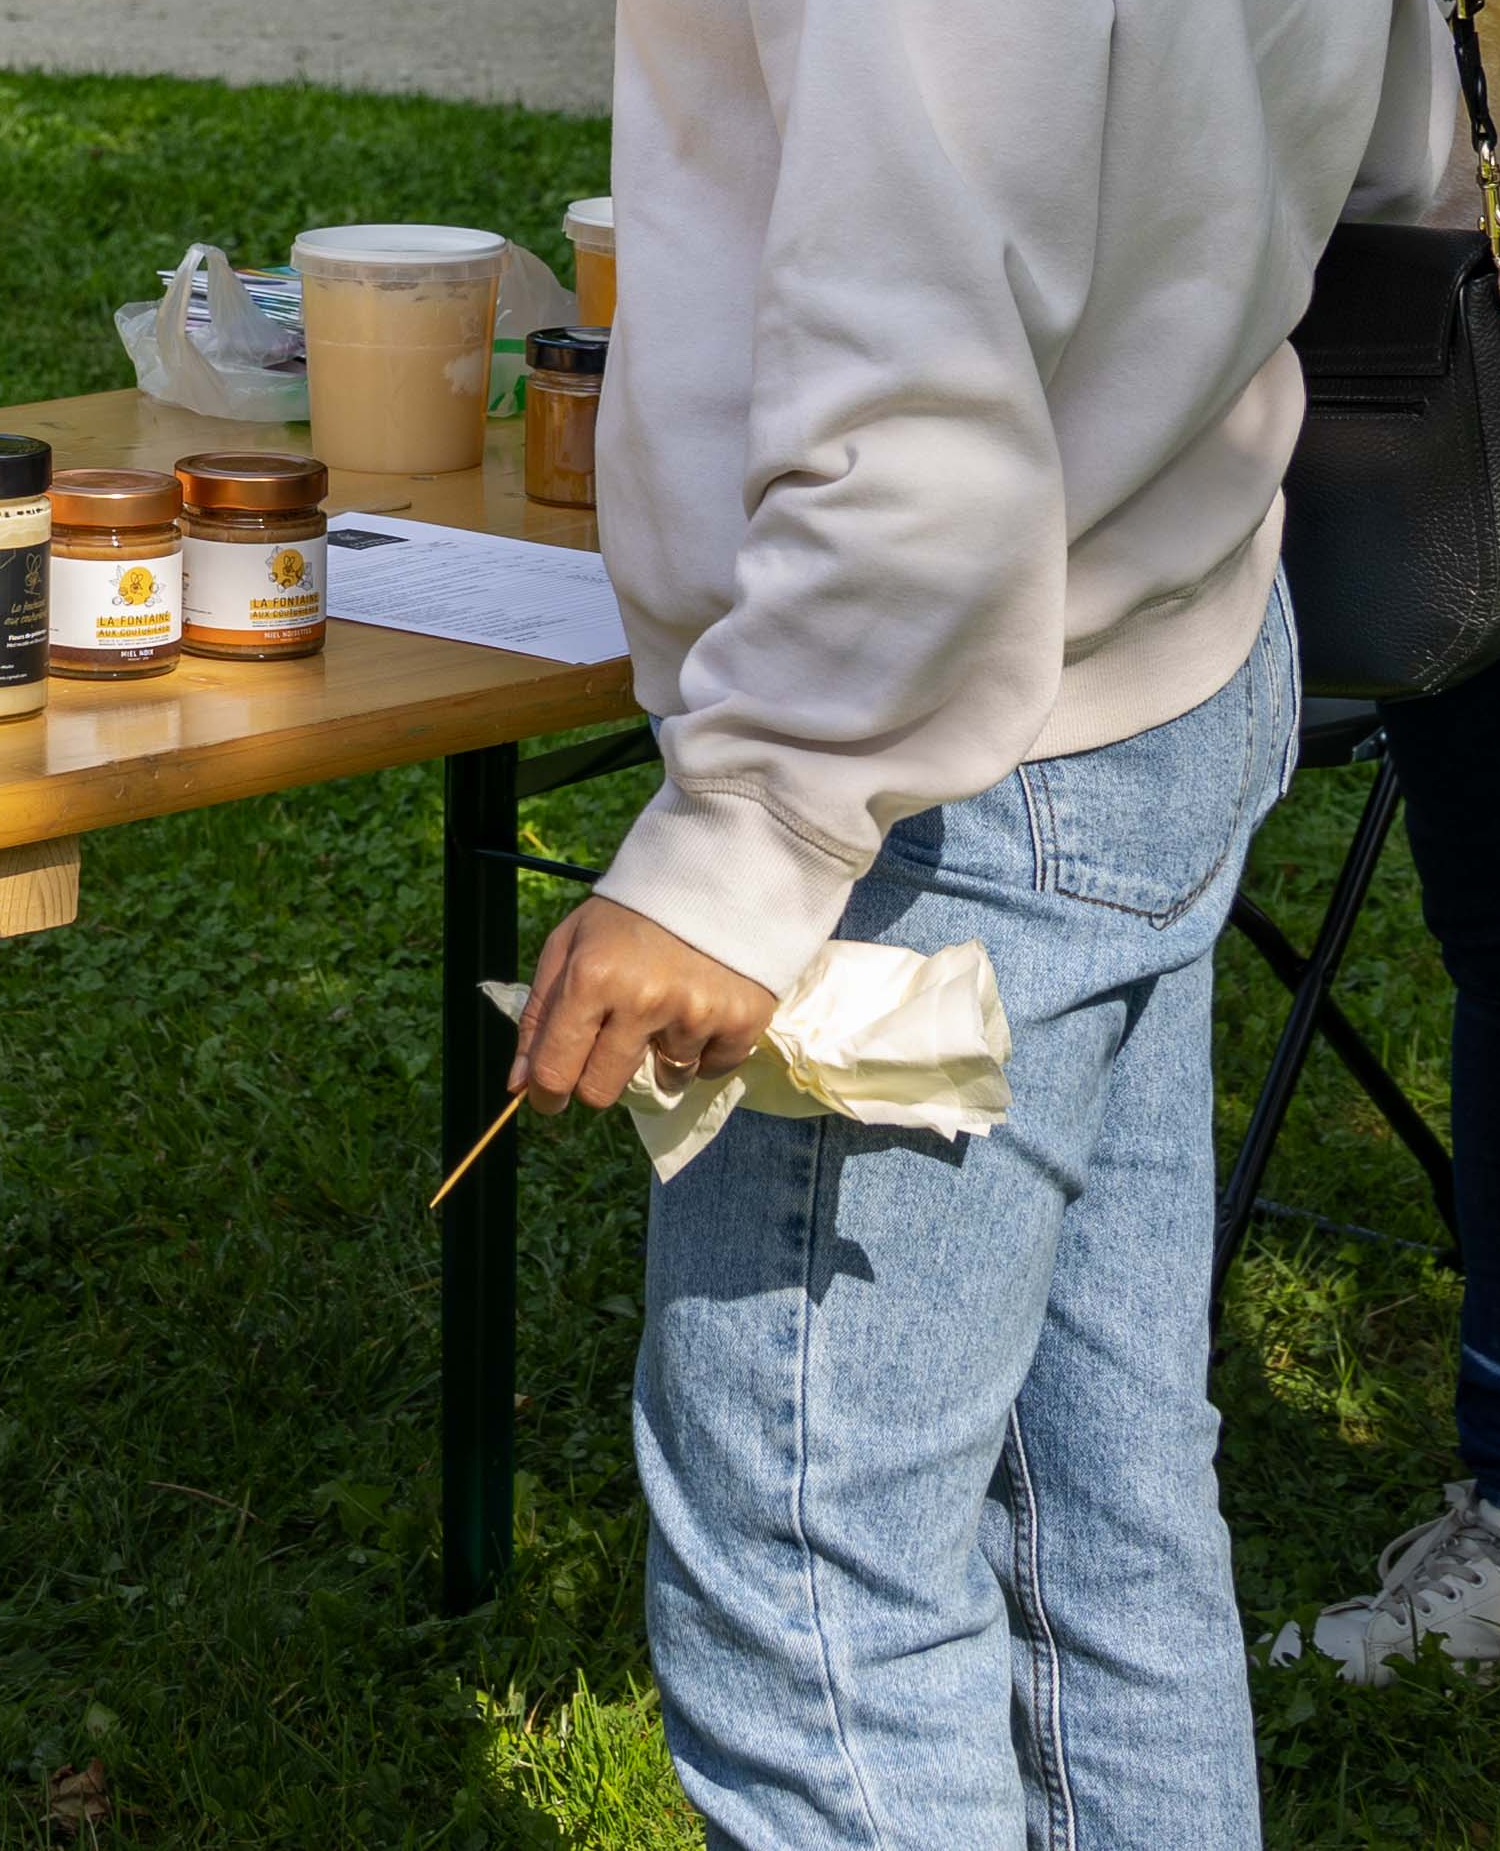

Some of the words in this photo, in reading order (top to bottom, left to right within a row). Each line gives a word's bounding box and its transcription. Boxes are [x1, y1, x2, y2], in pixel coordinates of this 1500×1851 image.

[253, 598, 268, 609] LA
[272, 593, 319, 608] FONTAINE
[100, 616, 115, 627] LA
[120, 611, 169, 627] FONTAINE
[251, 611, 270, 619] AUX
[99, 629, 118, 637] AUX
[121, 649, 137, 658] MIEL
